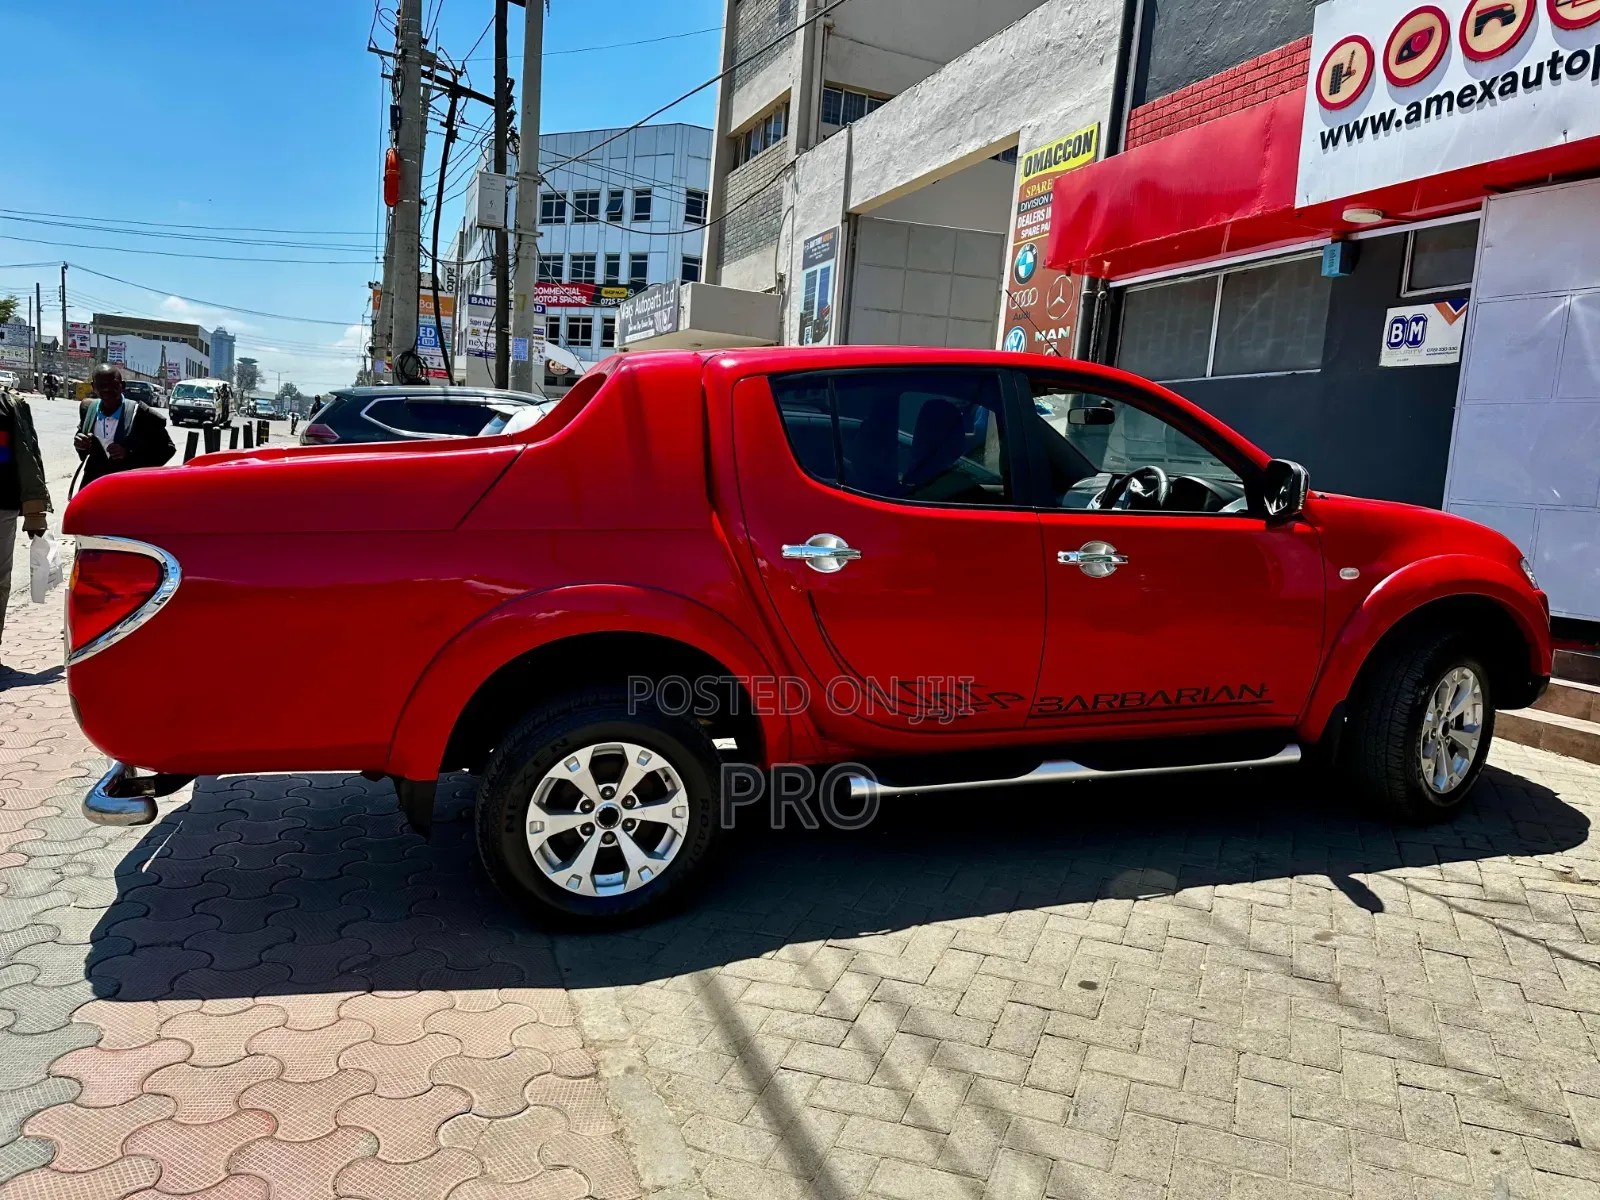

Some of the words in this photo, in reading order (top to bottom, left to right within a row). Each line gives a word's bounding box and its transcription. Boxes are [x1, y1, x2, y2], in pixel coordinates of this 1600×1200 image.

[1320, 44, 1600, 151] www.amexauto
[1023, 129, 1095, 178] OMACCON
[1026, 179, 1053, 198] SPARE
[1020, 195, 1049, 212] DIVISION
[1017, 208, 1046, 229] DEALERS
[1020, 225, 1041, 240] SPARE
[634, 290, 662, 317] Autoparts
[662, 284, 675, 306] Ltd
[1034, 326, 1071, 342] MAN
[1037, 682, 1269, 713] BARBARIAN
